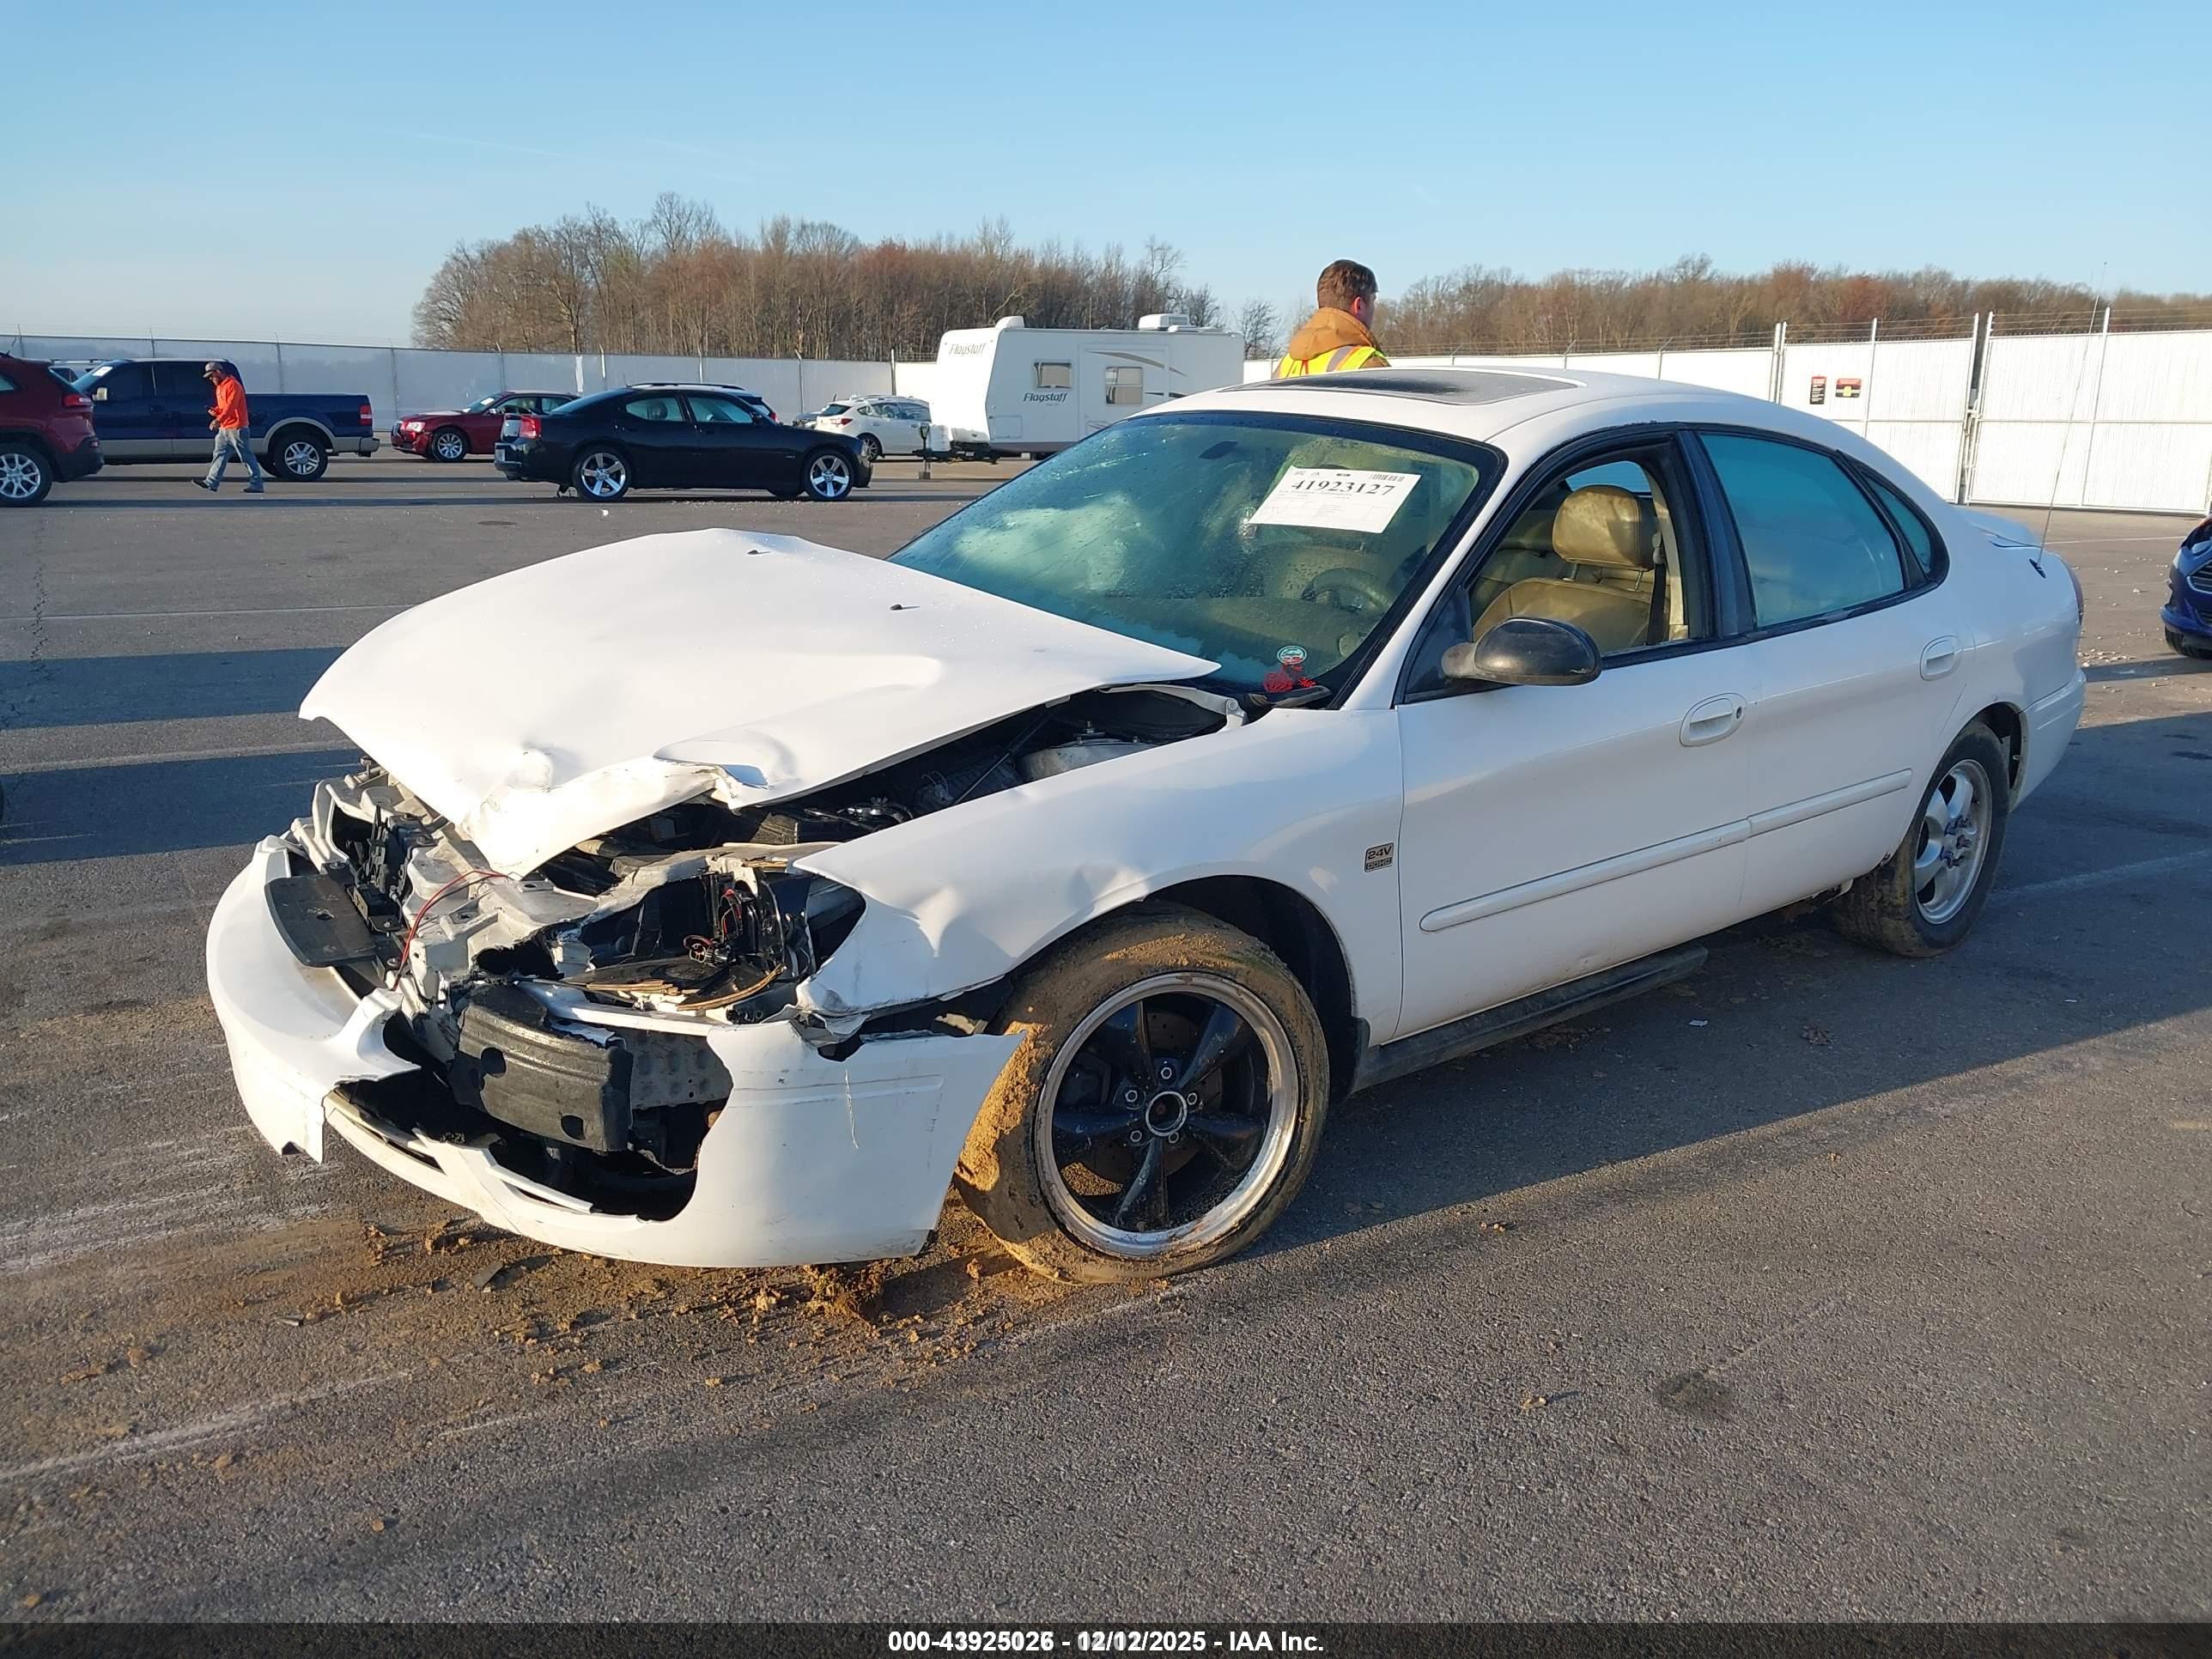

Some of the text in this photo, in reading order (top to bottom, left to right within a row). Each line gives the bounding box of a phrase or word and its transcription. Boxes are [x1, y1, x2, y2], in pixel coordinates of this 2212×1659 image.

[949, 343, 987, 356] Flagstaff
[1024, 392, 1067, 403] Flagstaff
[1291, 479, 1396, 495] 41923127
[1368, 845, 1392, 860] 24V
